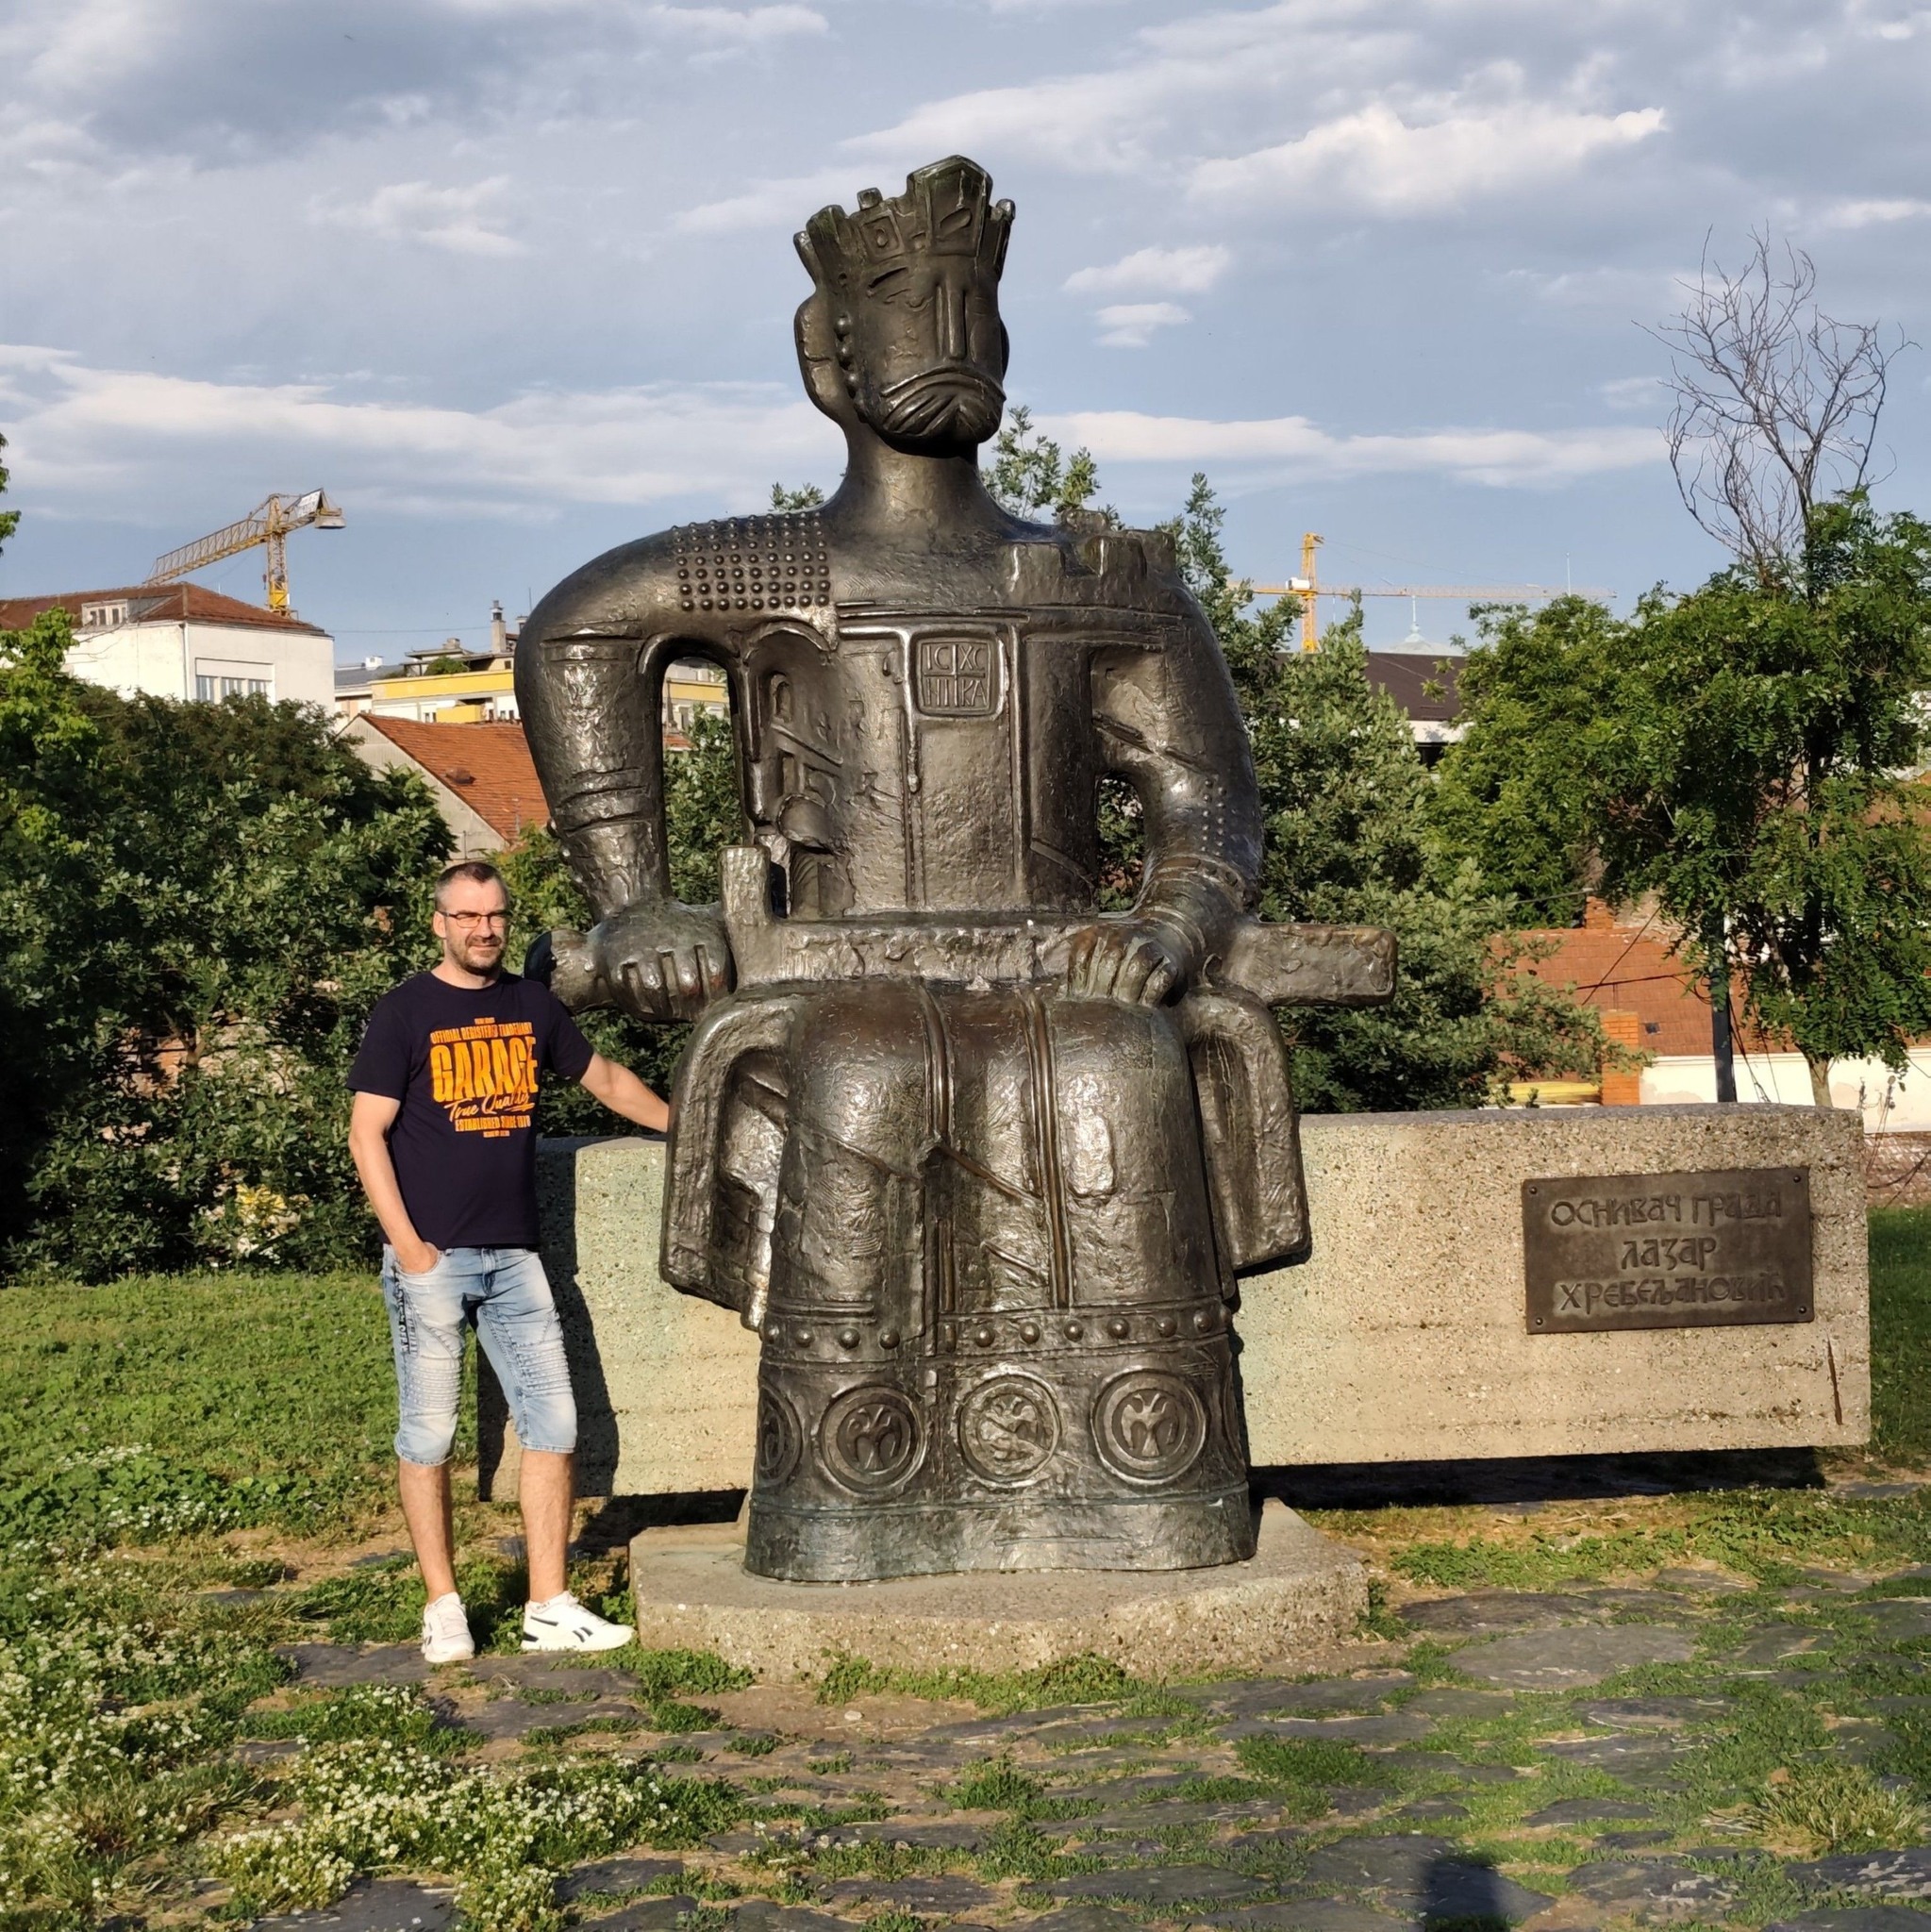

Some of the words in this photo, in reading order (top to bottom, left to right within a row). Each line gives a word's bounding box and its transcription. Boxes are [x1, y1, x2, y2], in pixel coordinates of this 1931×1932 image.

[430, 1028, 461, 1044] OFFICIAL
[430, 1036, 539, 1103] GARAGE
[443, 1098, 479, 1122] True
[455, 1116, 501, 1132] ESTABLISHED
